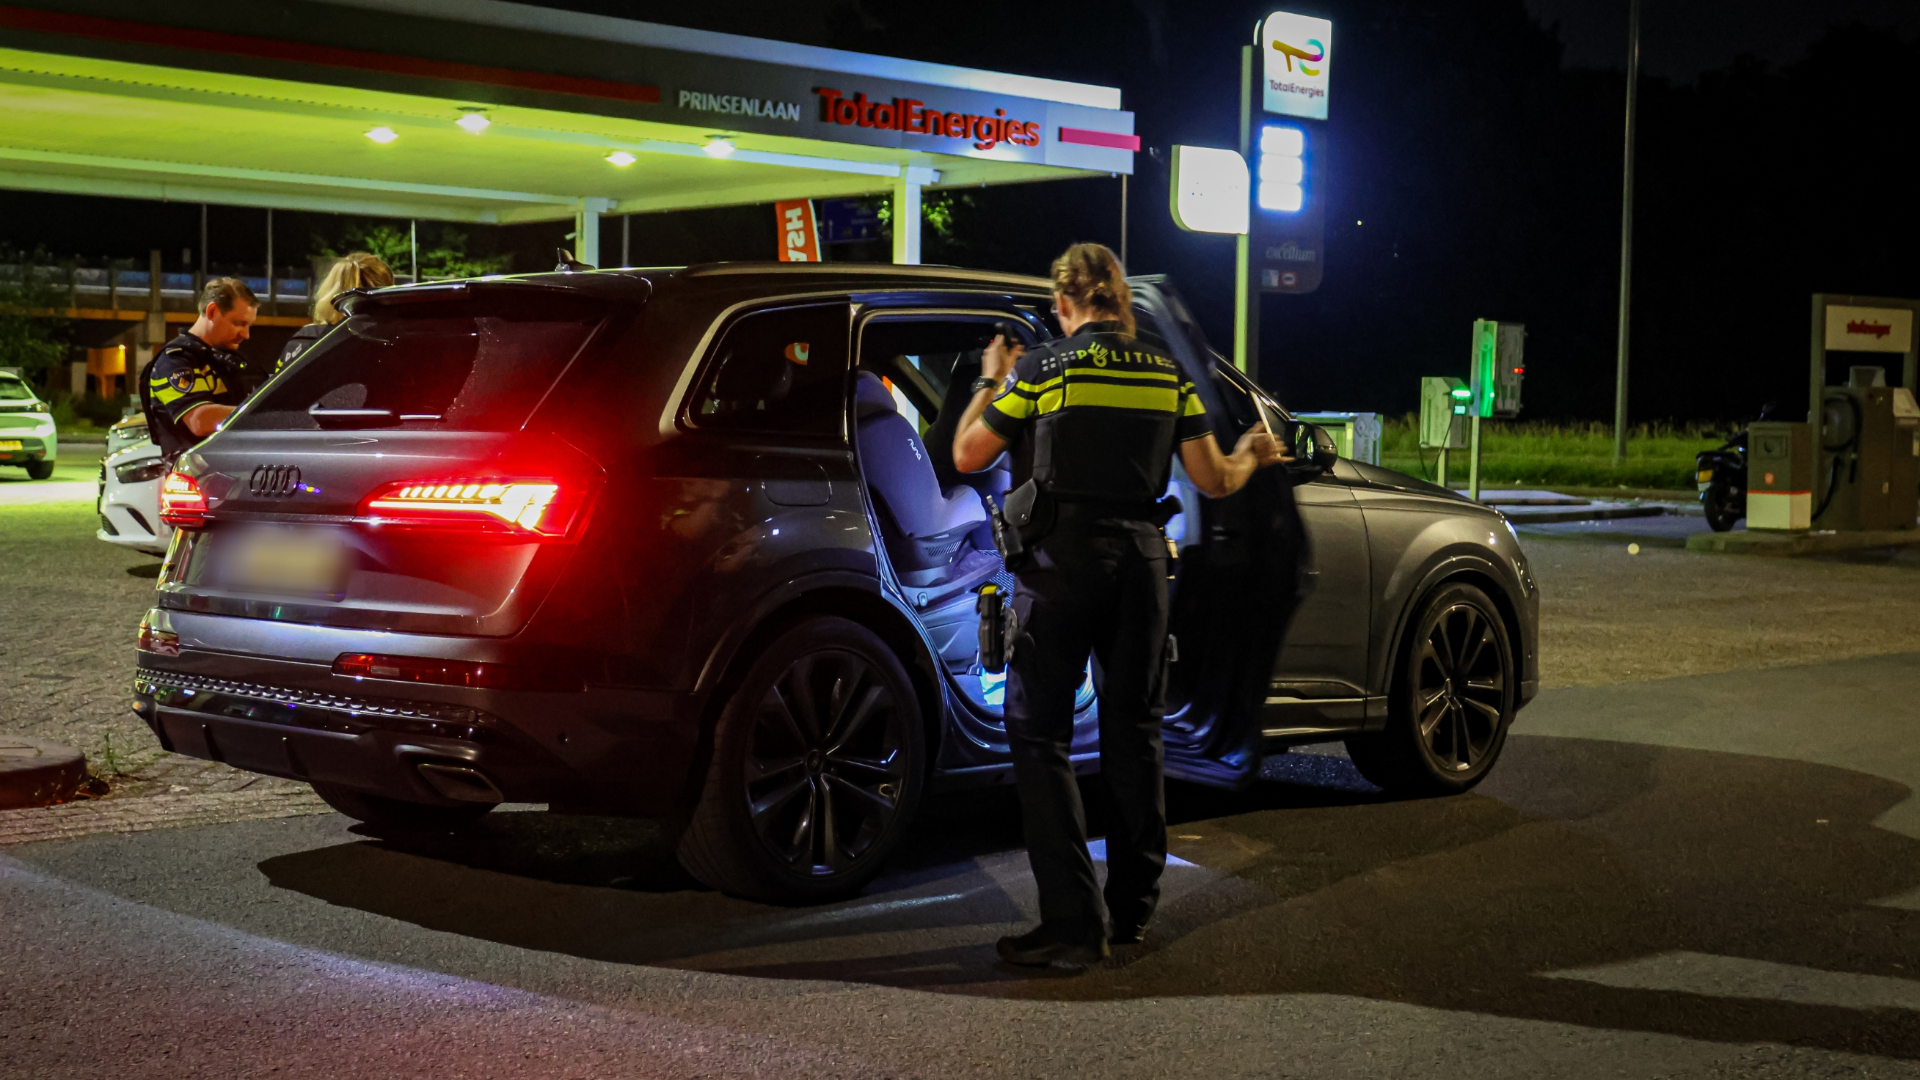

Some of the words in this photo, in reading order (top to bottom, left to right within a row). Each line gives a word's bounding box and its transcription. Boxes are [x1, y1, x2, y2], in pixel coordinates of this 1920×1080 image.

[1269, 79, 1325, 98] TotalEnergies
[678, 89, 801, 122] PRINSENLAAN
[815, 87, 1041, 150] TotalEnergies
[1076, 344, 1162, 368] POLITIE
[907, 438, 922, 461] nuna
